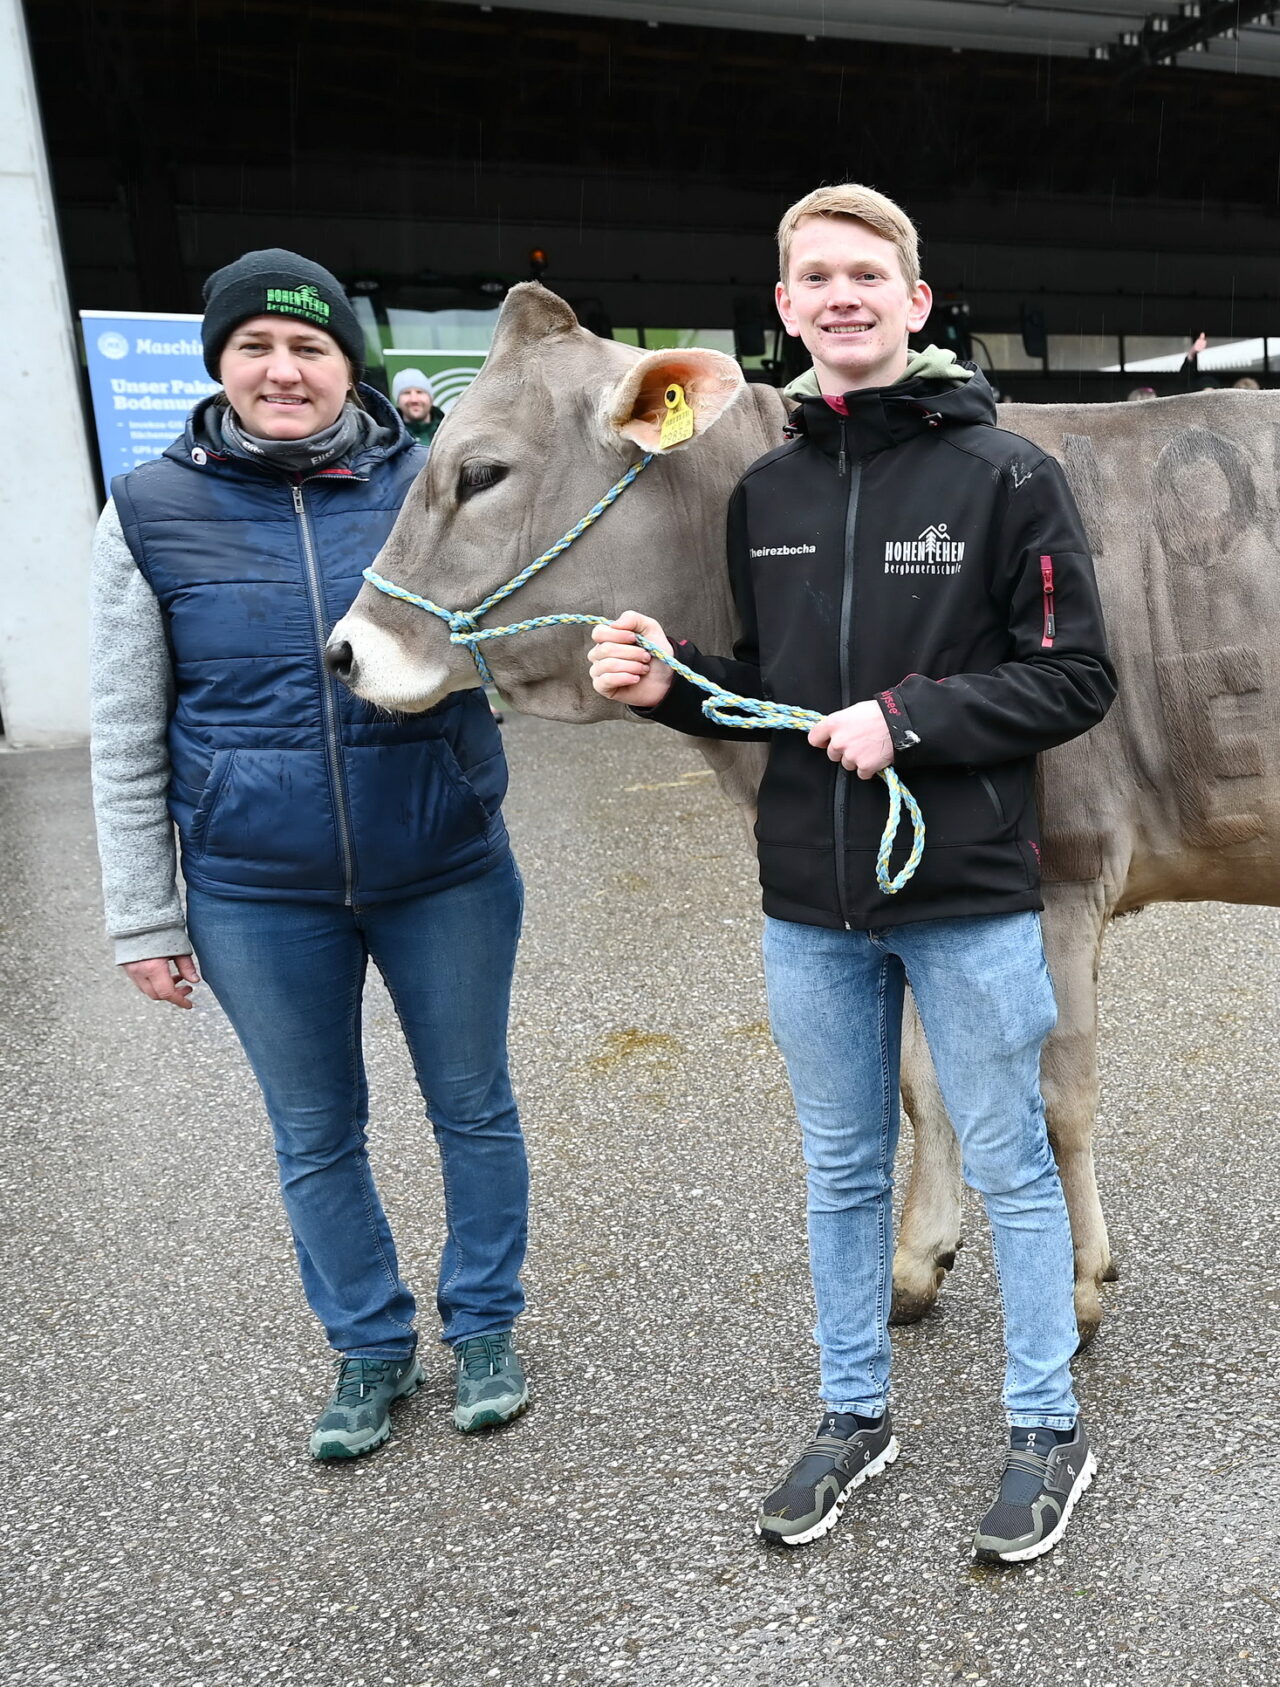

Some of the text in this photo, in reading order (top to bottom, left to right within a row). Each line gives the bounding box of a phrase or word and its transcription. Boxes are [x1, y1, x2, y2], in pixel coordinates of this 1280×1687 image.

[111, 379, 168, 394] Unser
[749, 543, 817, 560] heirezbocha
[885, 540, 965, 564] HOHENLEHEN
[884, 562, 962, 576] Bergbauernschule
